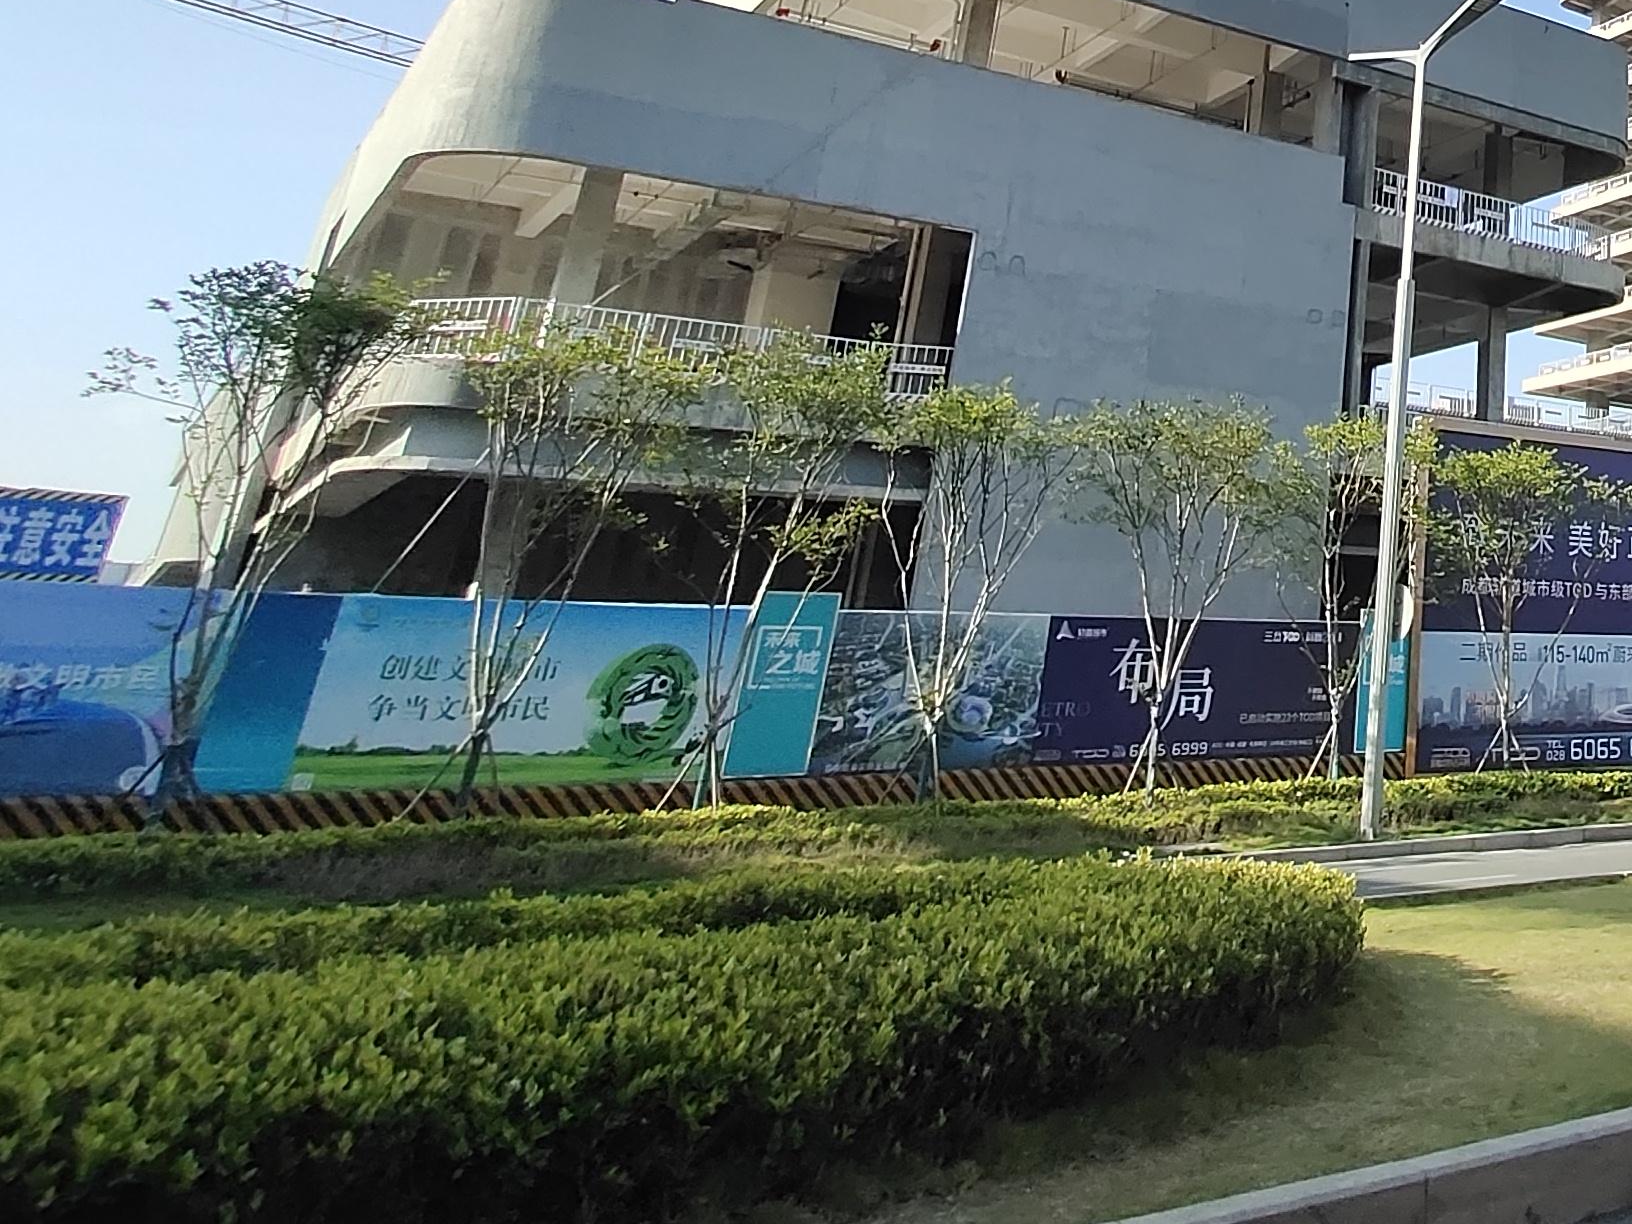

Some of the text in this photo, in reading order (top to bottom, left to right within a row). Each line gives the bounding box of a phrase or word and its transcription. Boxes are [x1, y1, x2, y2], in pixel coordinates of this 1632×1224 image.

[378, 653, 562, 682] 创建文市
[1129, 743, 1166, 758] 605
[1171, 742, 1208, 756] 6999
[1546, 739, 1565, 749] TEL
[1570, 737, 1621, 761] 6065
[1546, 749, 1566, 762] 028
